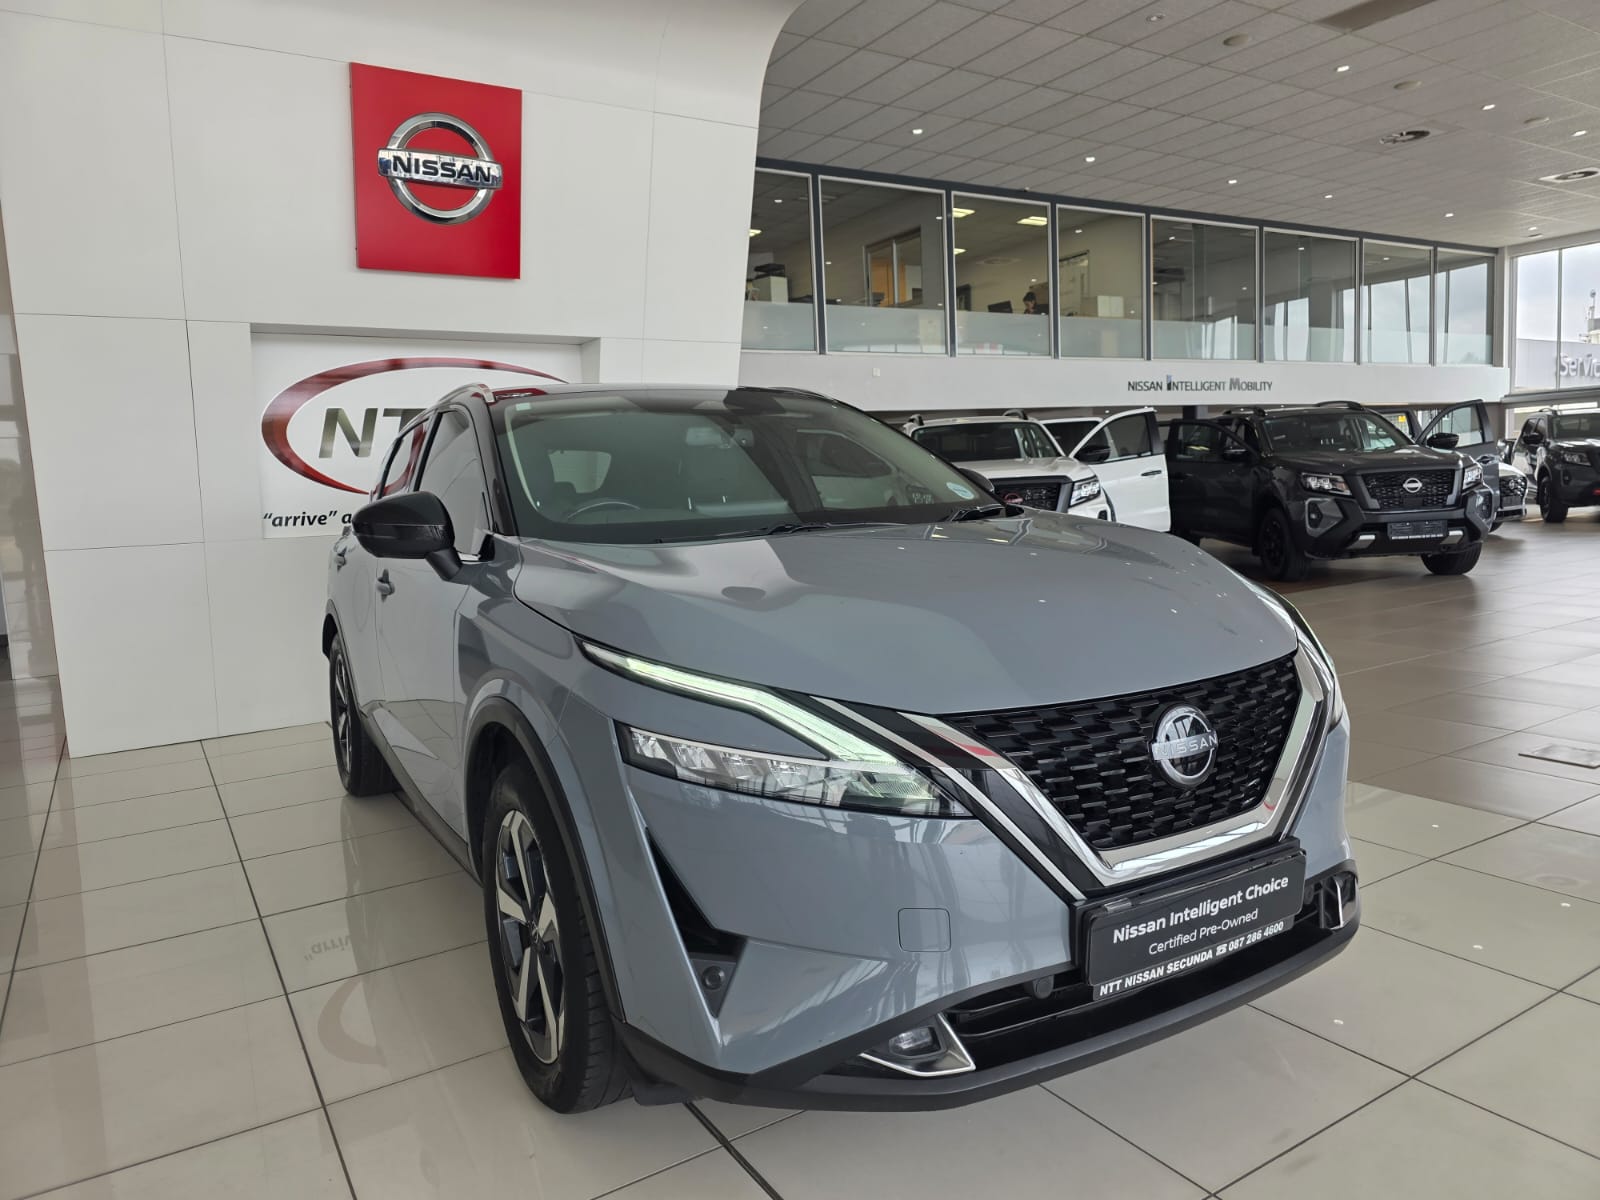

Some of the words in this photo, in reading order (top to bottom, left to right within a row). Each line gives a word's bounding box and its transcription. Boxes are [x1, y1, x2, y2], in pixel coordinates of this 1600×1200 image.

[392, 155, 491, 183] NISSAN
[1127, 380, 1163, 392] NISSAN
[1154, 734, 1218, 757] NISSAN
[1113, 917, 1166, 944] Nissan
[1169, 890, 1243, 927] Intelligent
[1245, 876, 1289, 900] Choice
[1148, 929, 1197, 955] Certified
[1199, 908, 1259, 939] Pre-Owned
[1099, 979, 1122, 996] NTT
[1124, 965, 1164, 988] NISSAN
[1166, 949, 1213, 974] SECUNDA
[1228, 937, 1245, 952] 087
[1246, 929, 1262, 945] 286
[1263, 921, 1284, 937] 4600
